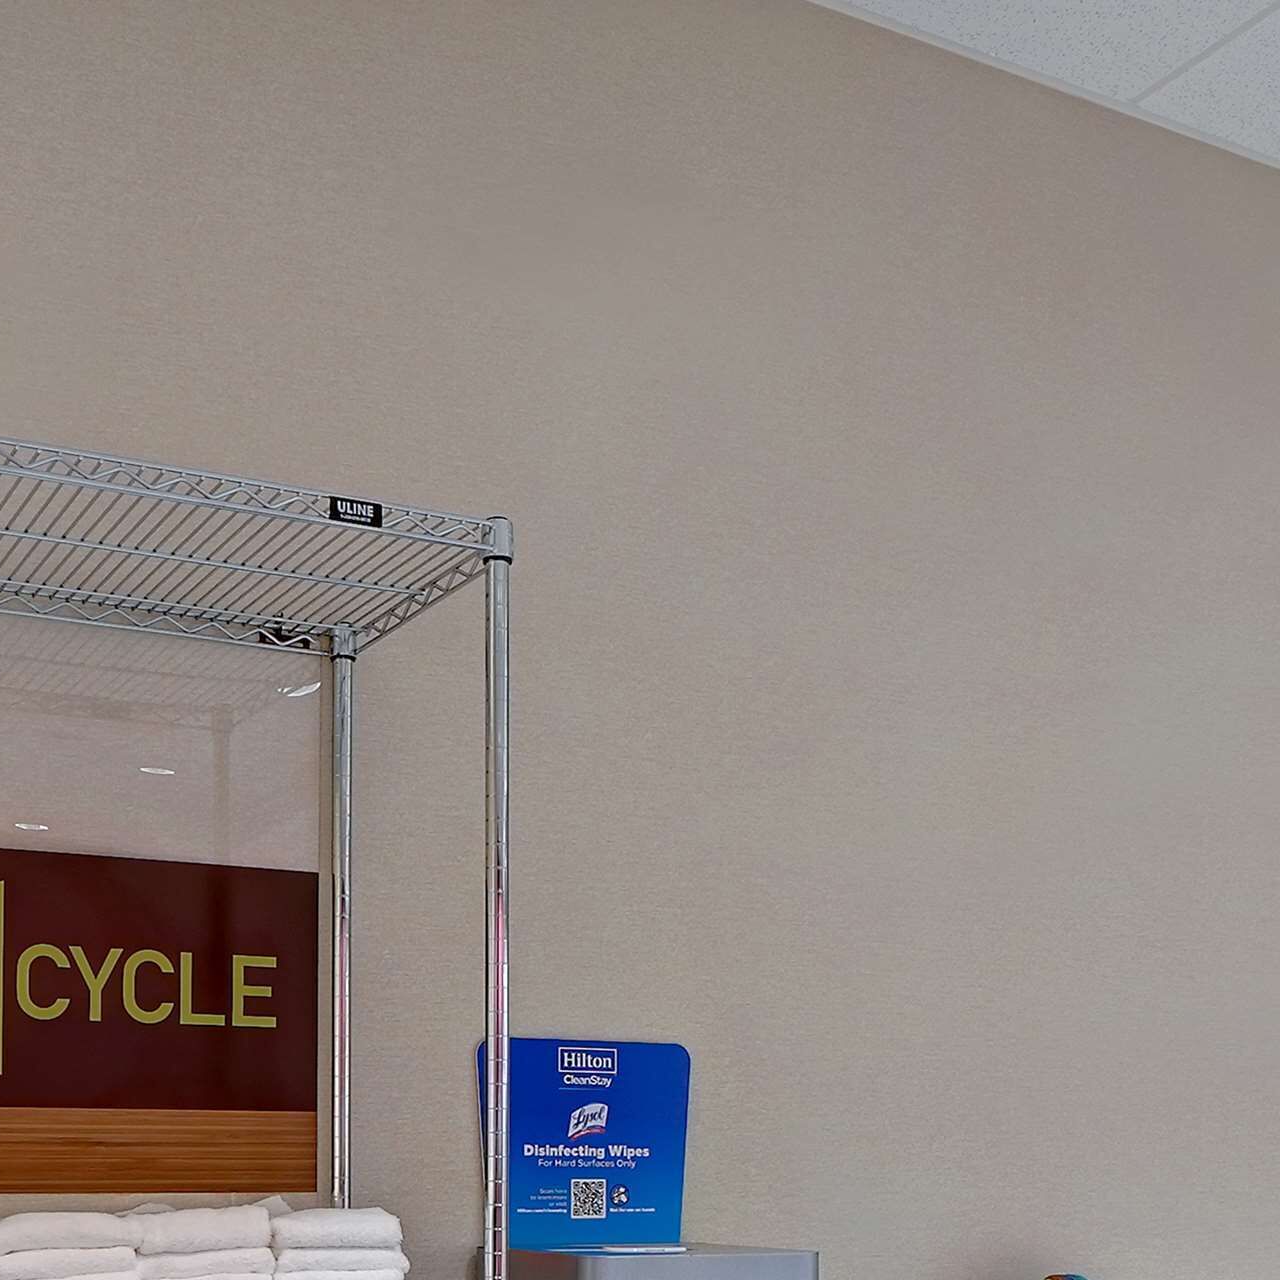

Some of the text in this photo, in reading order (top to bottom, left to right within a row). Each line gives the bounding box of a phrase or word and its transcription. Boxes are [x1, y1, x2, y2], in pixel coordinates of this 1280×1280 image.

[337, 500, 374, 517] ULINE
[16, 942, 278, 1029] CYCLE
[563, 1052, 612, 1069] Hilton
[563, 1074, 612, 1088] CleanStay
[572, 1106, 605, 1129] Lysol
[523, 1144, 650, 1160] Disinfecting Wipes
[538, 1159, 636, 1169] For Hard Surfaces Only
